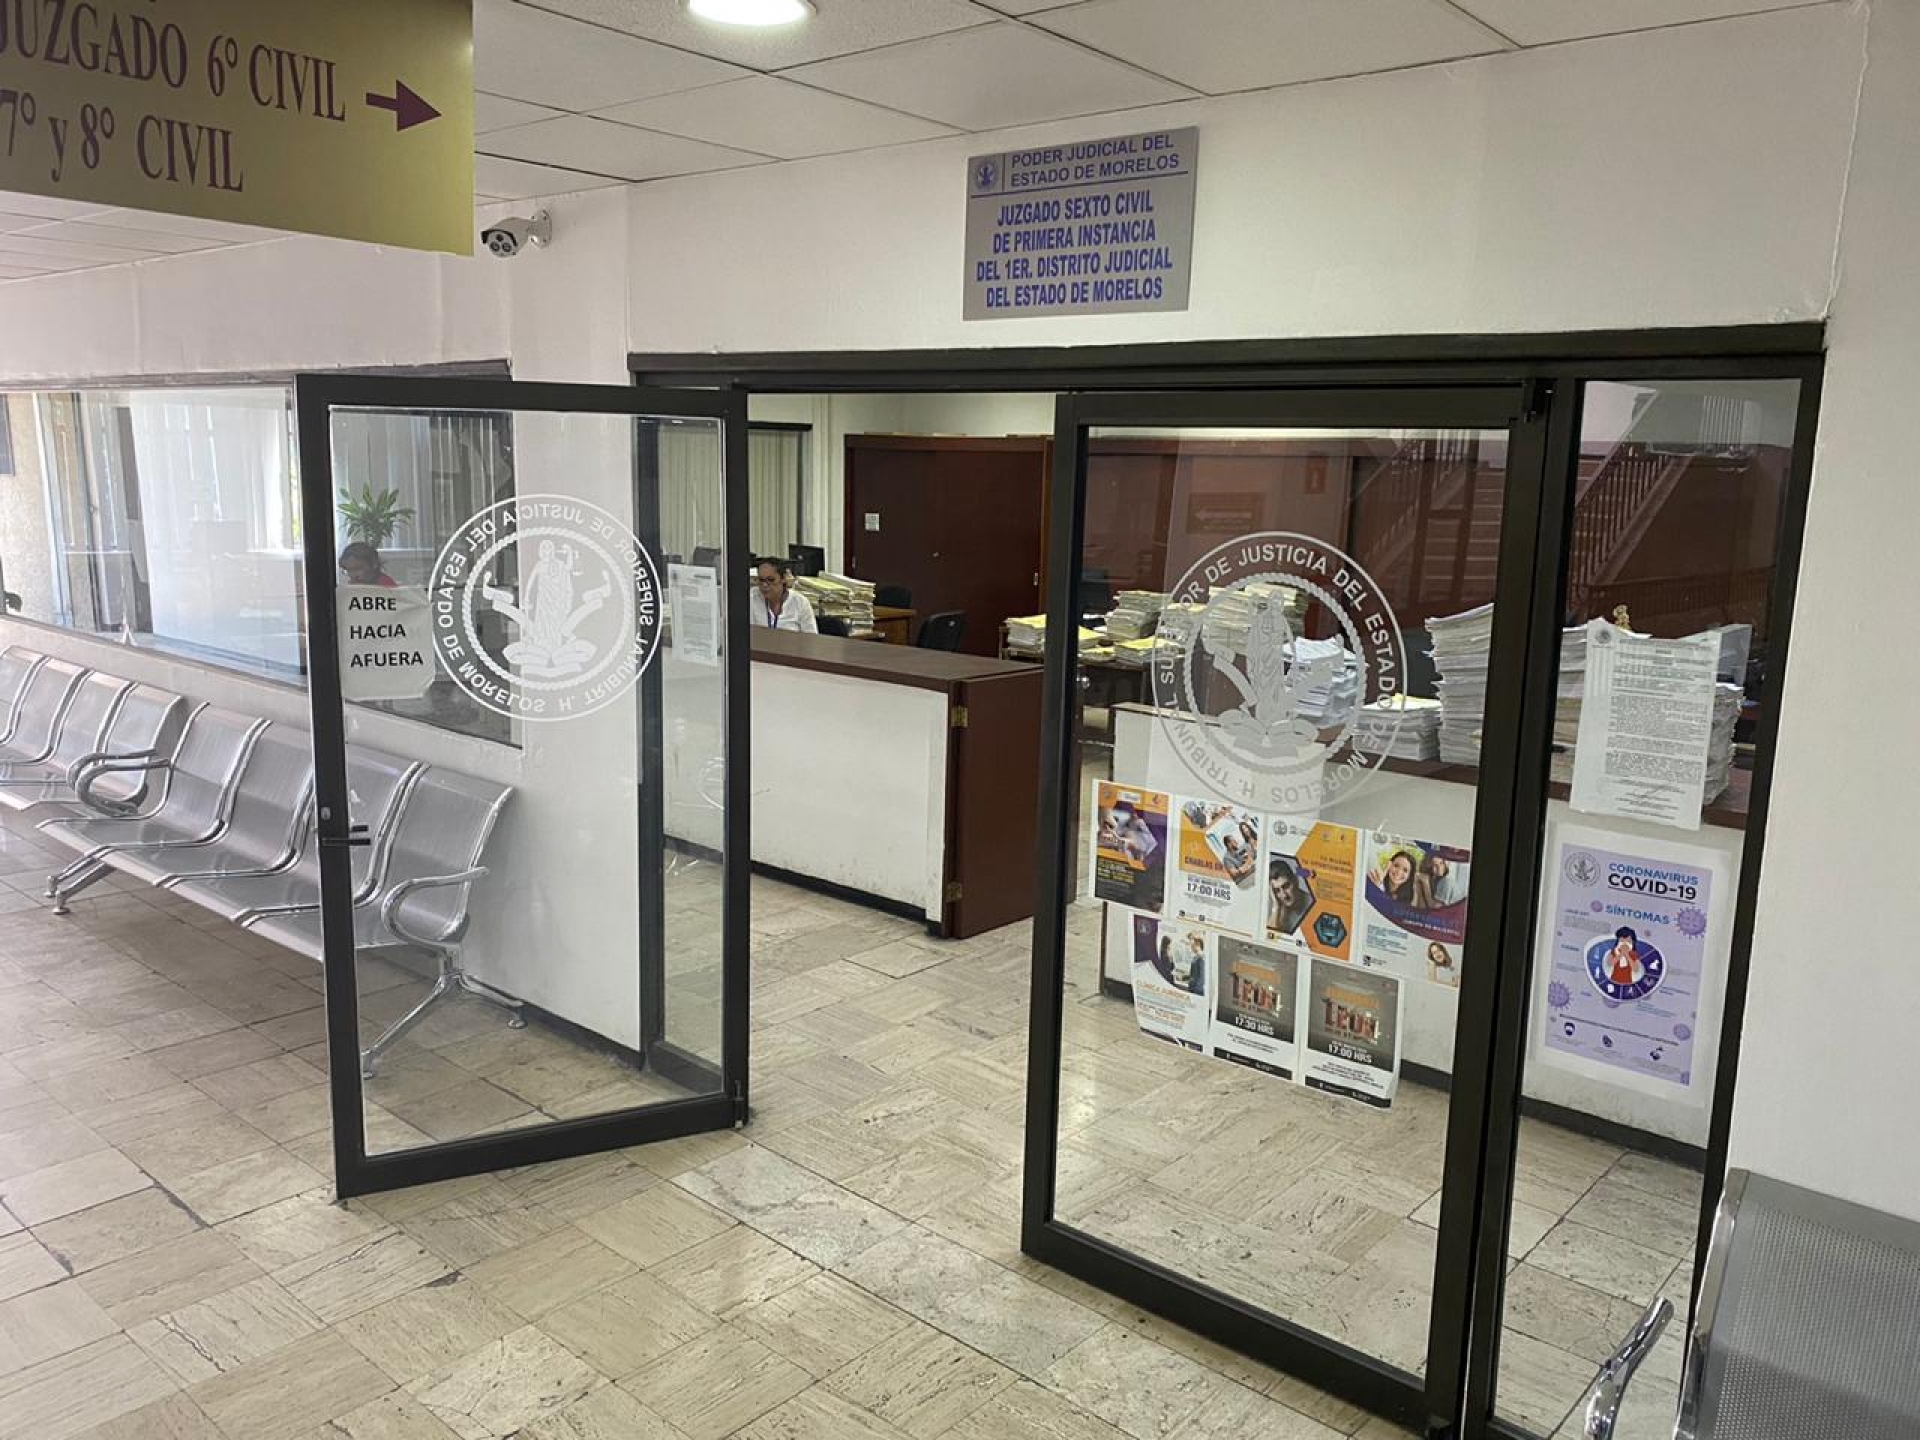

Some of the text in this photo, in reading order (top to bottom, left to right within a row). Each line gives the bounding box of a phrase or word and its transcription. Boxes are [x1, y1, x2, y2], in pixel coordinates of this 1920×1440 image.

[249, 43, 346, 122] CIVIL
[48, 116, 68, 183] y
[138, 115, 243, 192] CIVIL
[1011, 134, 1174, 168] PODER JUDICIAL DEL
[1011, 153, 1179, 187] ESTADO DE MORELOS
[998, 190, 1153, 226] JUZGADO SEXTO CIVIL
[993, 219, 1156, 254] DE PRIMERA INSTANCIA
[977, 246, 1173, 282] DEL 1ER. DISTRITO JUDICIAL
[986, 276, 1162, 308] DEL ESTADO DE MORELOS
[349, 597, 397, 612] ABRE
[350, 623, 406, 640] HACIA
[1204, 557, 1232, 582] DE
[1239, 544, 1328, 575] JUSTICIA
[1332, 567, 1367, 612] DEL
[1365, 612, 1396, 710] ESTADO
[350, 651, 424, 668] AFUERA
[1608, 863, 1699, 886] CORONAVIRUS
[1608, 873, 1696, 900] COVID-19
